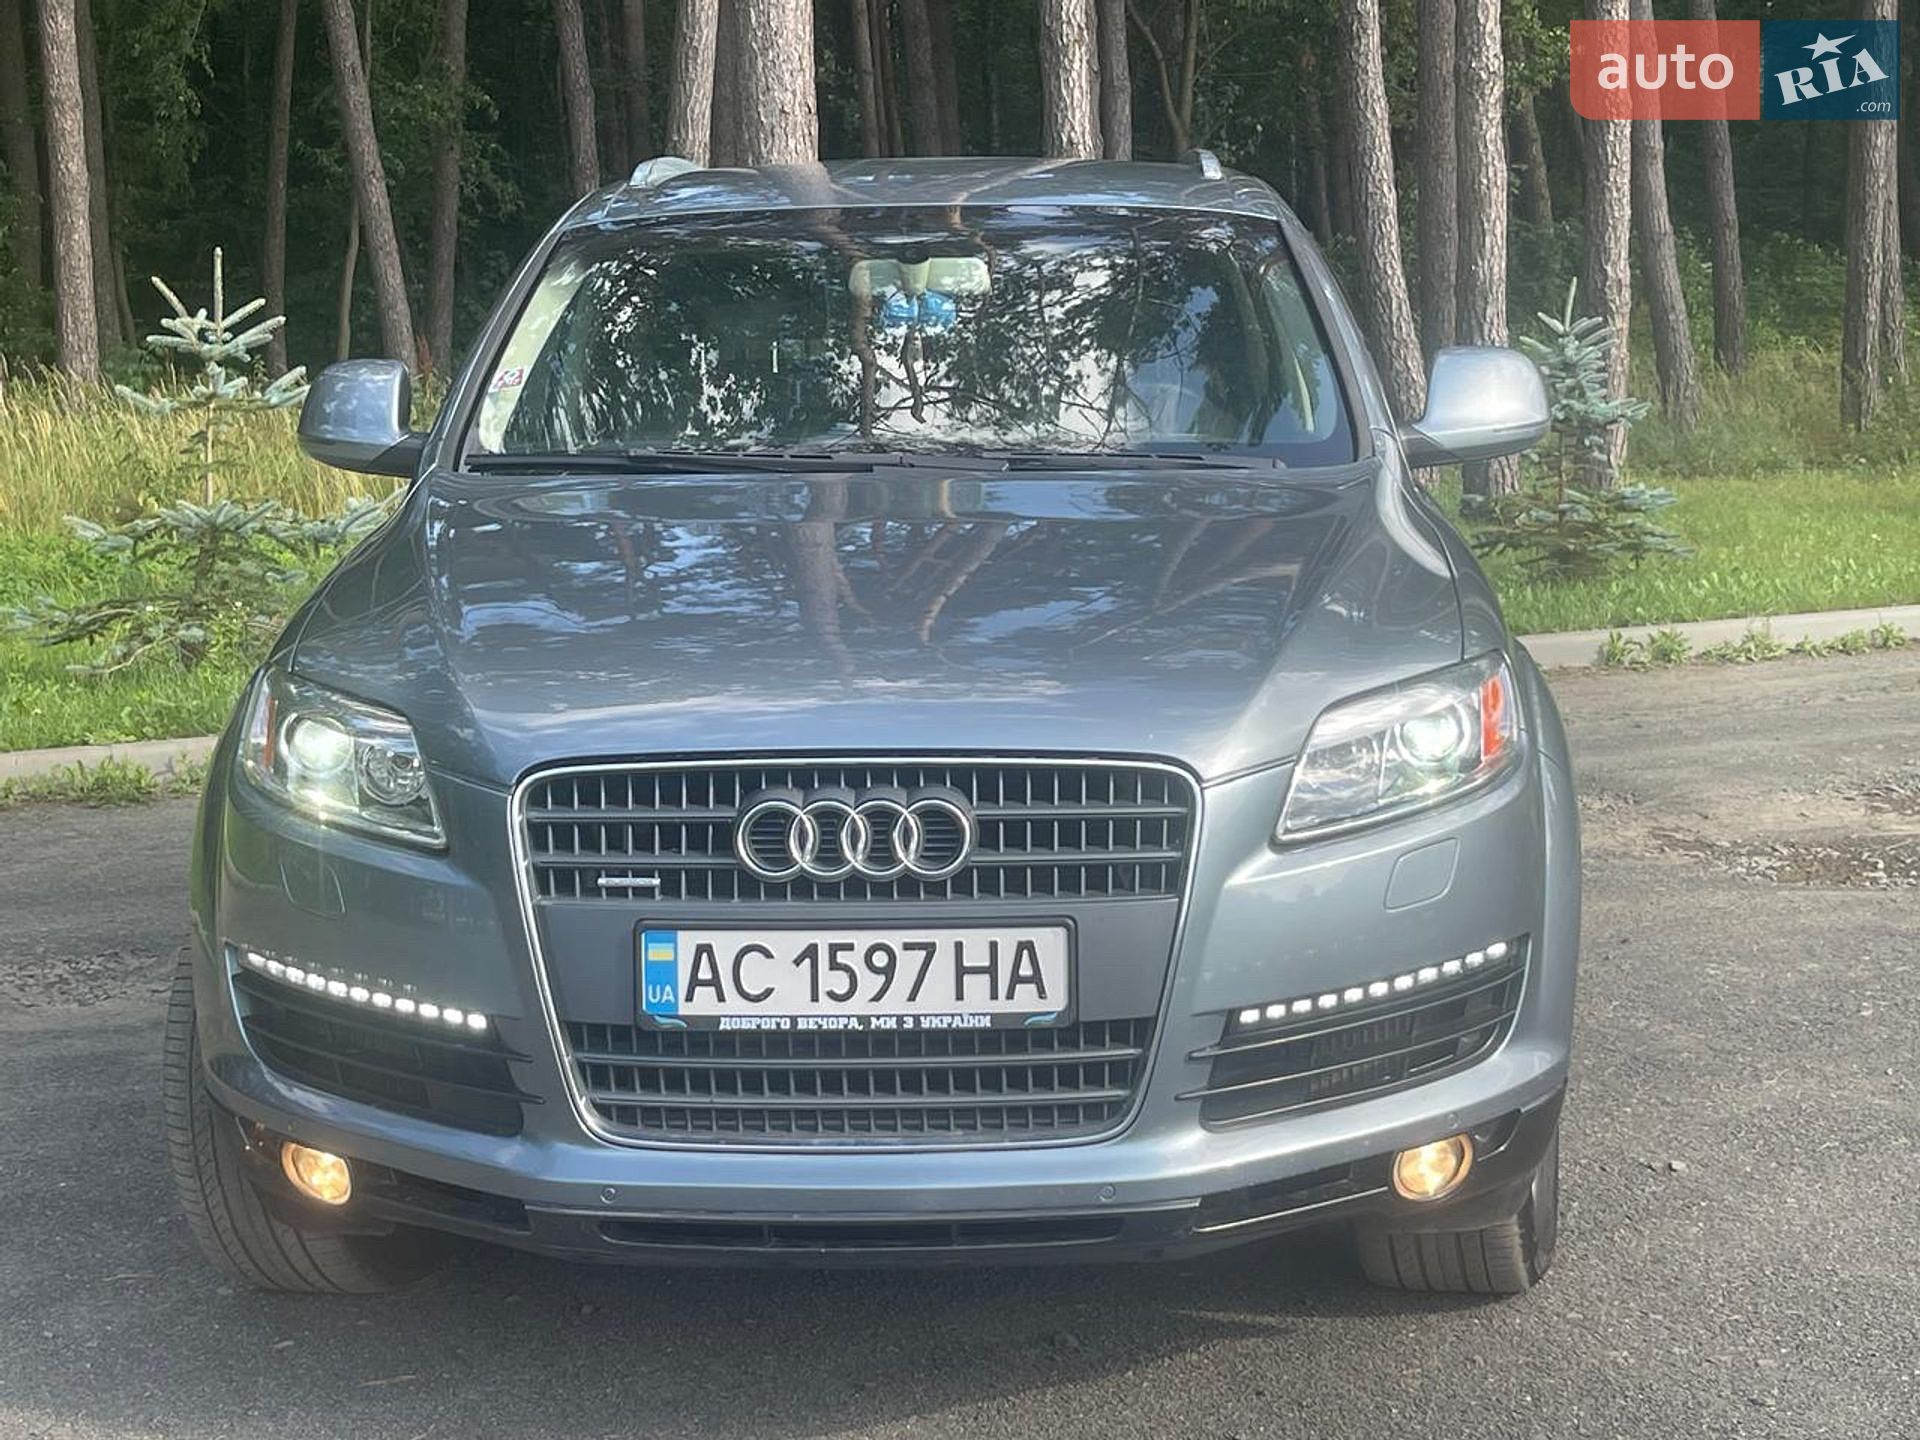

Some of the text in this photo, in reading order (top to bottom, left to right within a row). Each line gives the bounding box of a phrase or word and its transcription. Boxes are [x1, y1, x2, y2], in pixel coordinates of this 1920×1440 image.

[684, 940, 1048, 1003] AC 1597 HA
[648, 984, 676, 1004] UA
[718, 1016, 791, 1031] ДОБРОГО
[797, 1016, 863, 1031] ВЕЧОРА,
[870, 1015, 898, 1029] МИ
[919, 1013, 992, 1028] УКРАЇНИ
